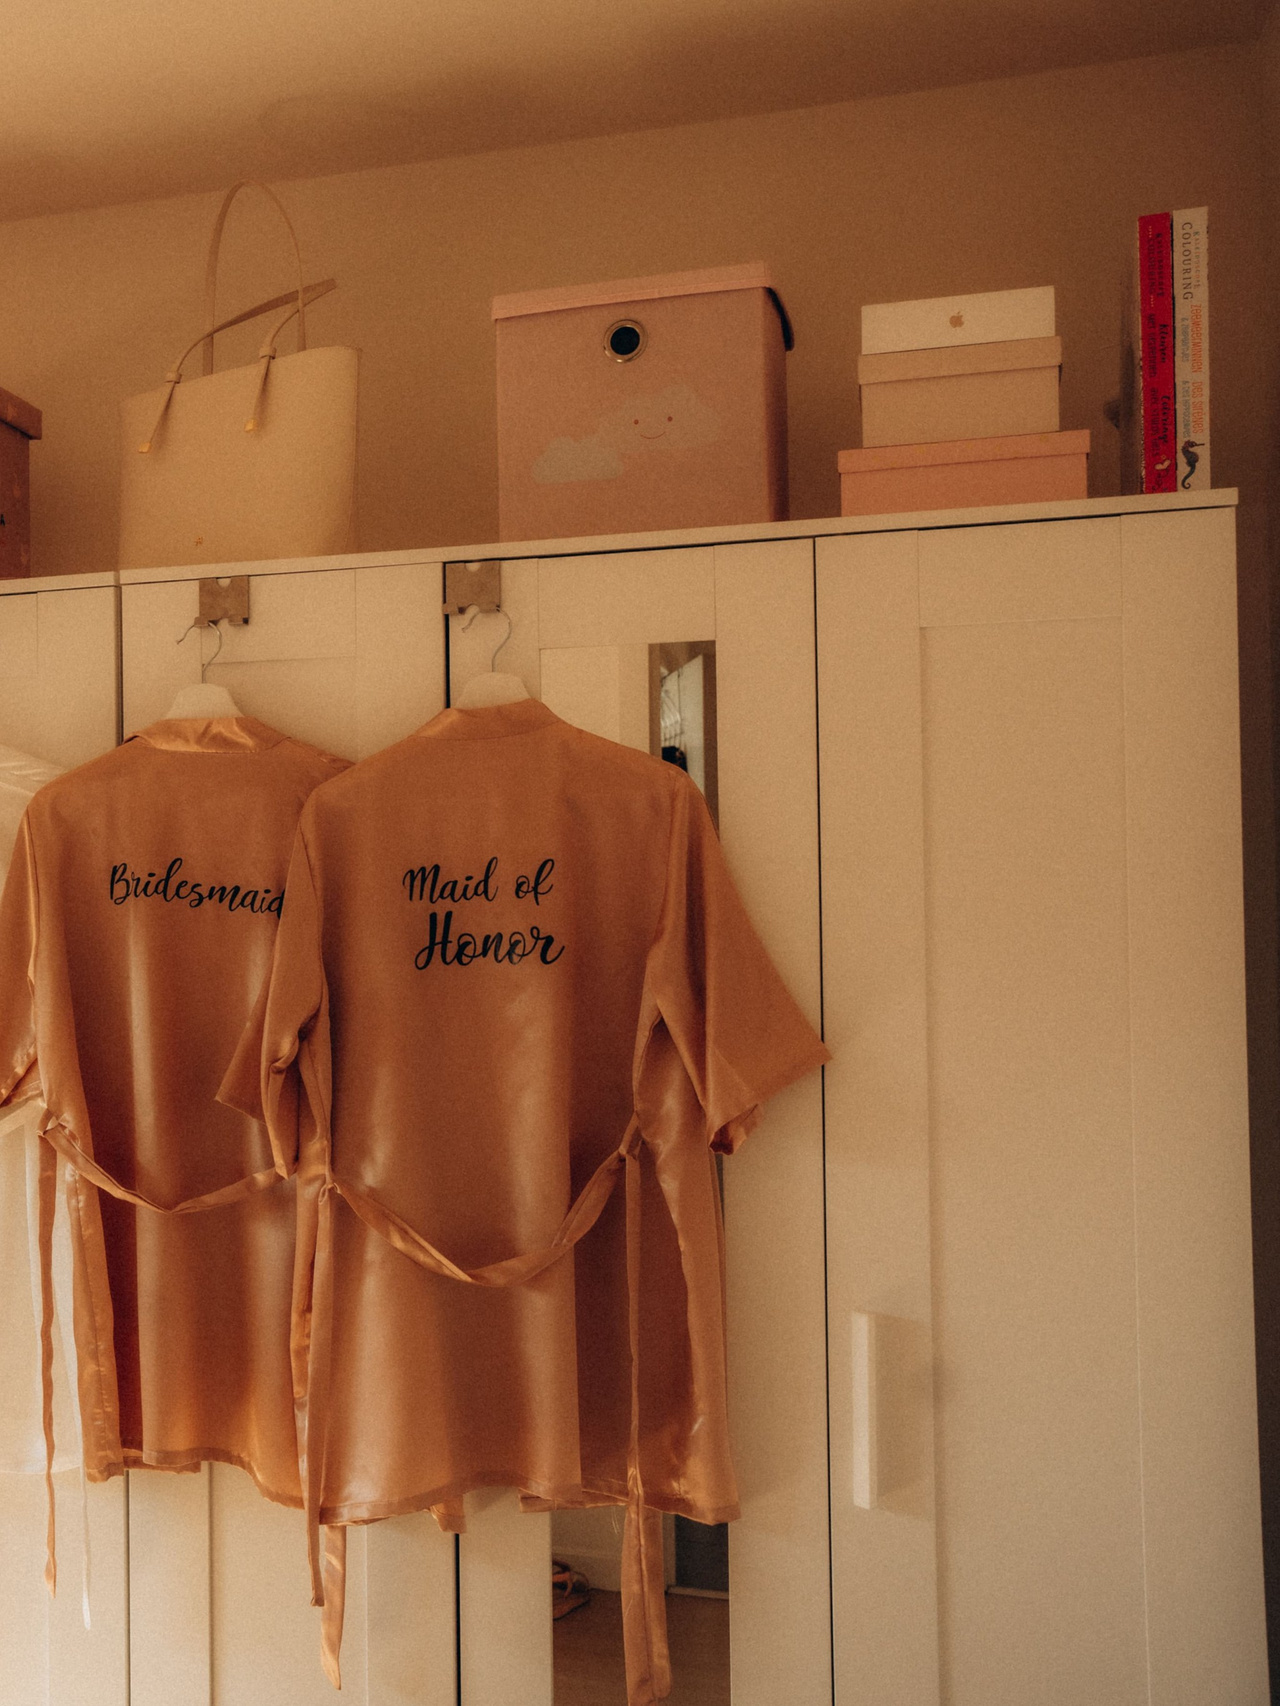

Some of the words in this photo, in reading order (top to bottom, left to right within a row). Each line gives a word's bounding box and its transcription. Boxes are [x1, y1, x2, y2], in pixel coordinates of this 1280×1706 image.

[1181, 221, 1194, 300] COLOURING
[402, 856, 499, 904] Maid
[514, 858, 555, 906] of
[414, 910, 566, 971] Honor
